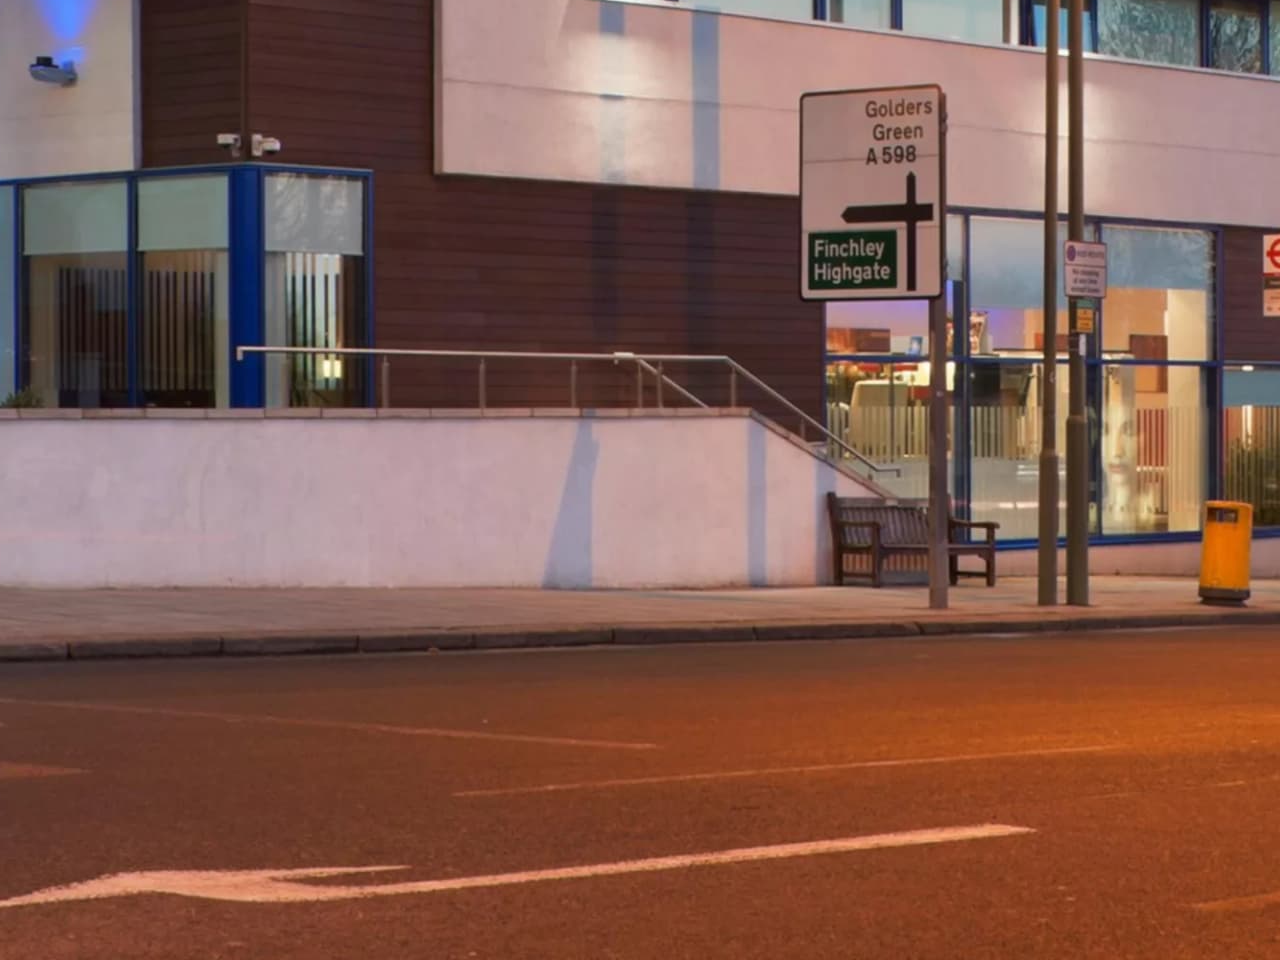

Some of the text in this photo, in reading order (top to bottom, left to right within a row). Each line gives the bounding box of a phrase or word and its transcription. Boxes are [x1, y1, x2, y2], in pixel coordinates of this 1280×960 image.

[865, 99, 933, 119] Golders
[872, 123, 924, 142] Green
[865, 144, 917, 166] A 598
[814, 240, 886, 260] Finchley
[814, 262, 891, 285] Highgate
